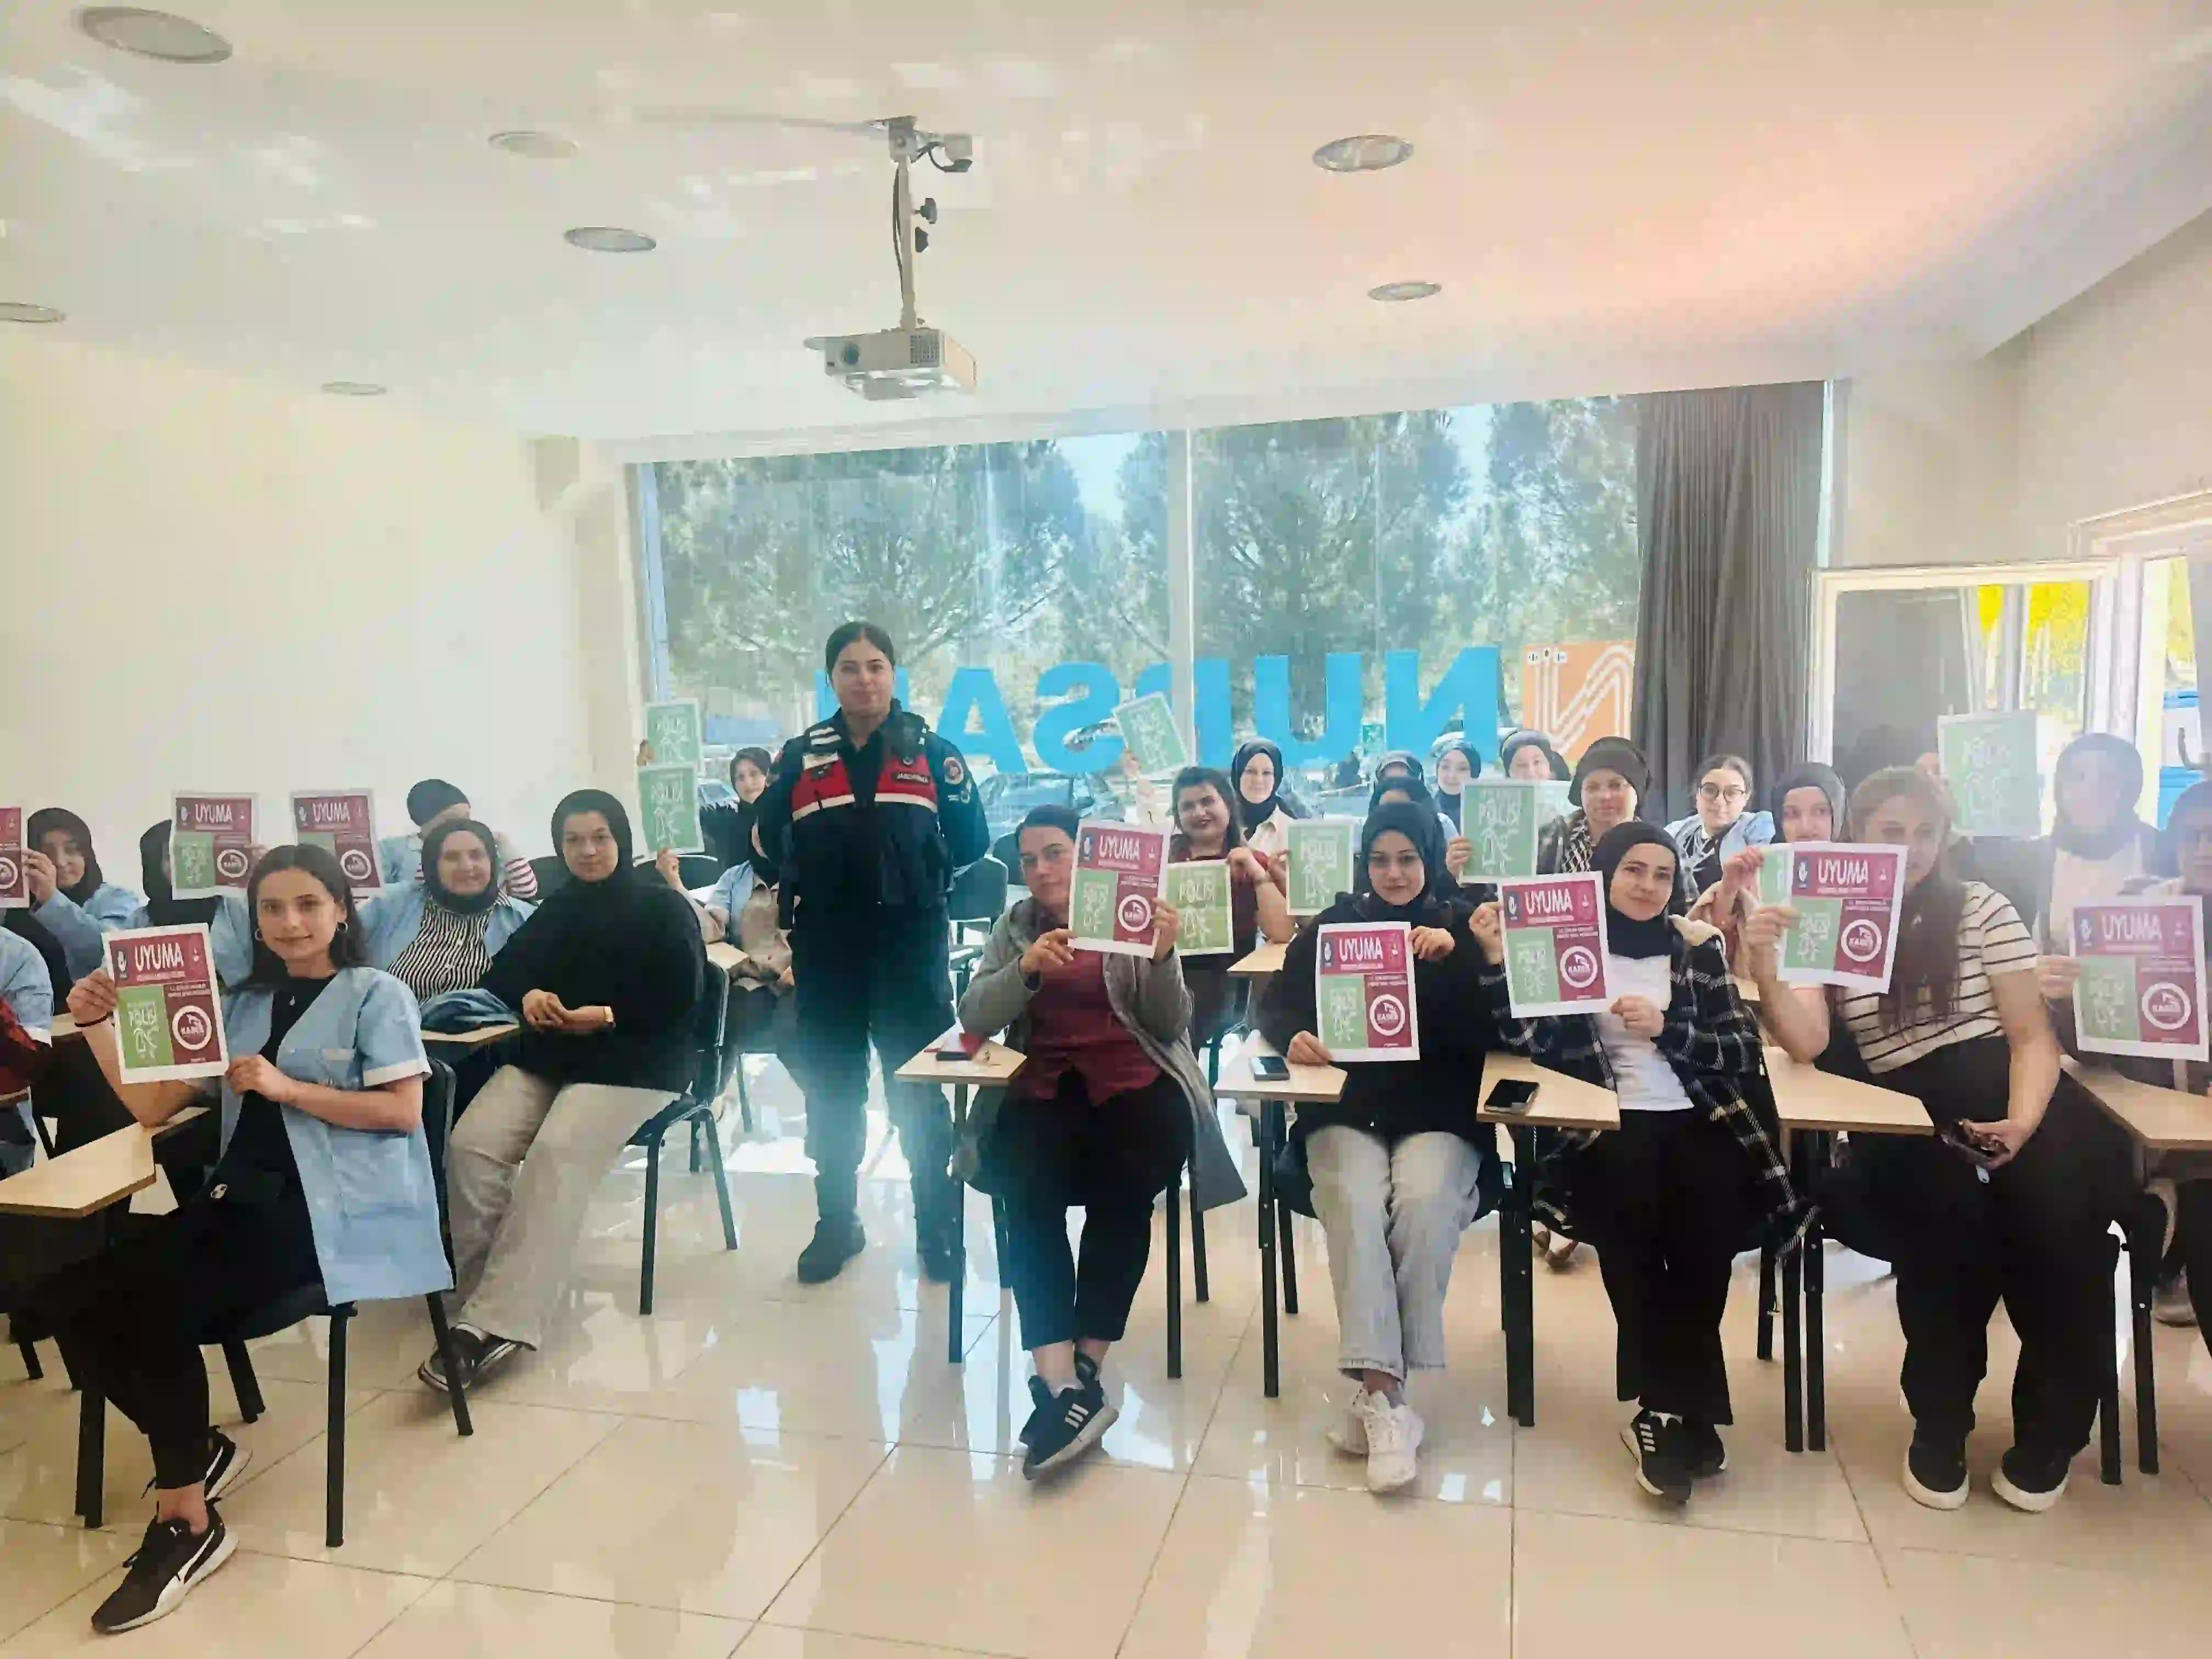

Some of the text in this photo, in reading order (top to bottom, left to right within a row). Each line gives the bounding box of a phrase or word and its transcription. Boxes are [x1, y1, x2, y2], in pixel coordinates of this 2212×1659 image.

[195, 803, 233, 824] UYUMA
[312, 802, 351, 822] UYUMA
[1098, 833, 1141, 861] UYUMA
[1817, 858, 1870, 885] UYUMA
[1524, 888, 1573, 915] UYUMA
[2101, 912, 2163, 941] UYUMA
[134, 942, 185, 972] UYUMA
[1339, 936, 1384, 962] UYUMA
